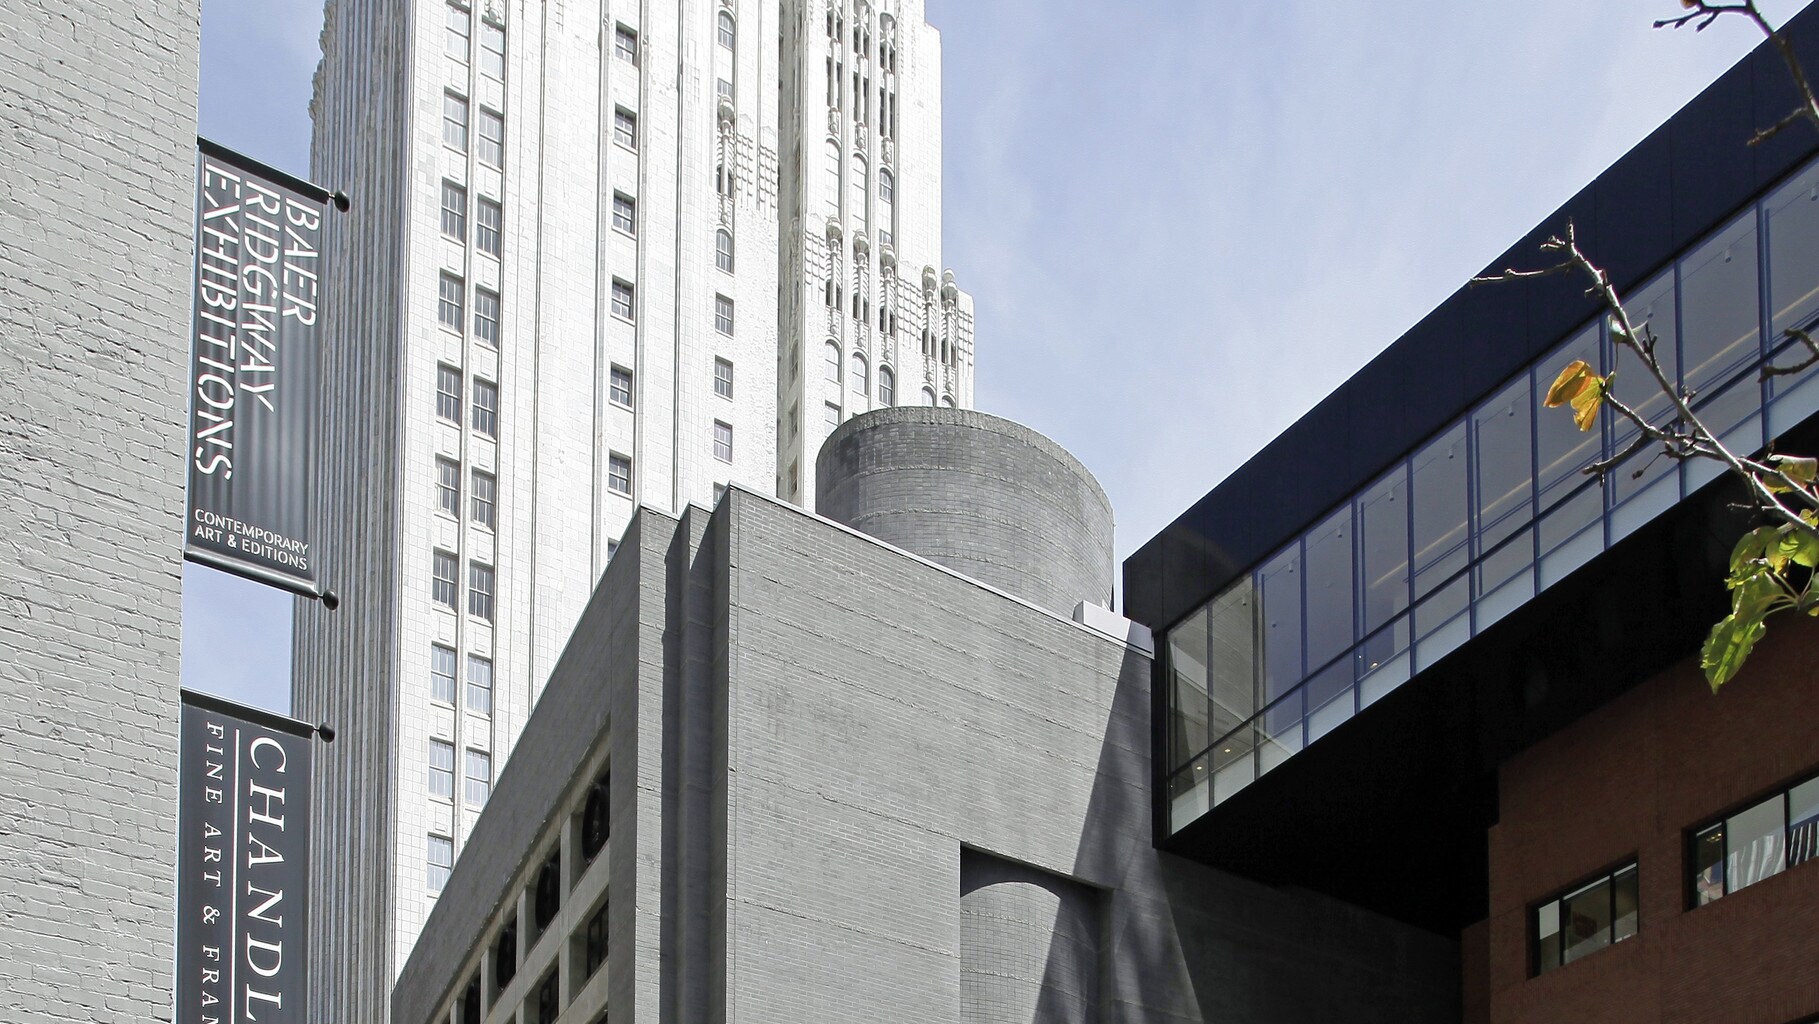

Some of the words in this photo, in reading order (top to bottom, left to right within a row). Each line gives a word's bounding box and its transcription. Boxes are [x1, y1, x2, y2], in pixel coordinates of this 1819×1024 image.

[239, 179, 281, 413] RIDGWAY
[282, 197, 320, 327] BAER
[194, 161, 241, 481] EXHIBITIONS
[194, 508, 309, 555] CONTEMPORARY
[194, 524, 223, 543] ART
[227, 534, 237, 549] &
[242, 538, 308, 571] EDITIONS
[204, 721, 225, 805] FINE
[203, 822, 222, 888] ART
[202, 905, 220, 926] &
